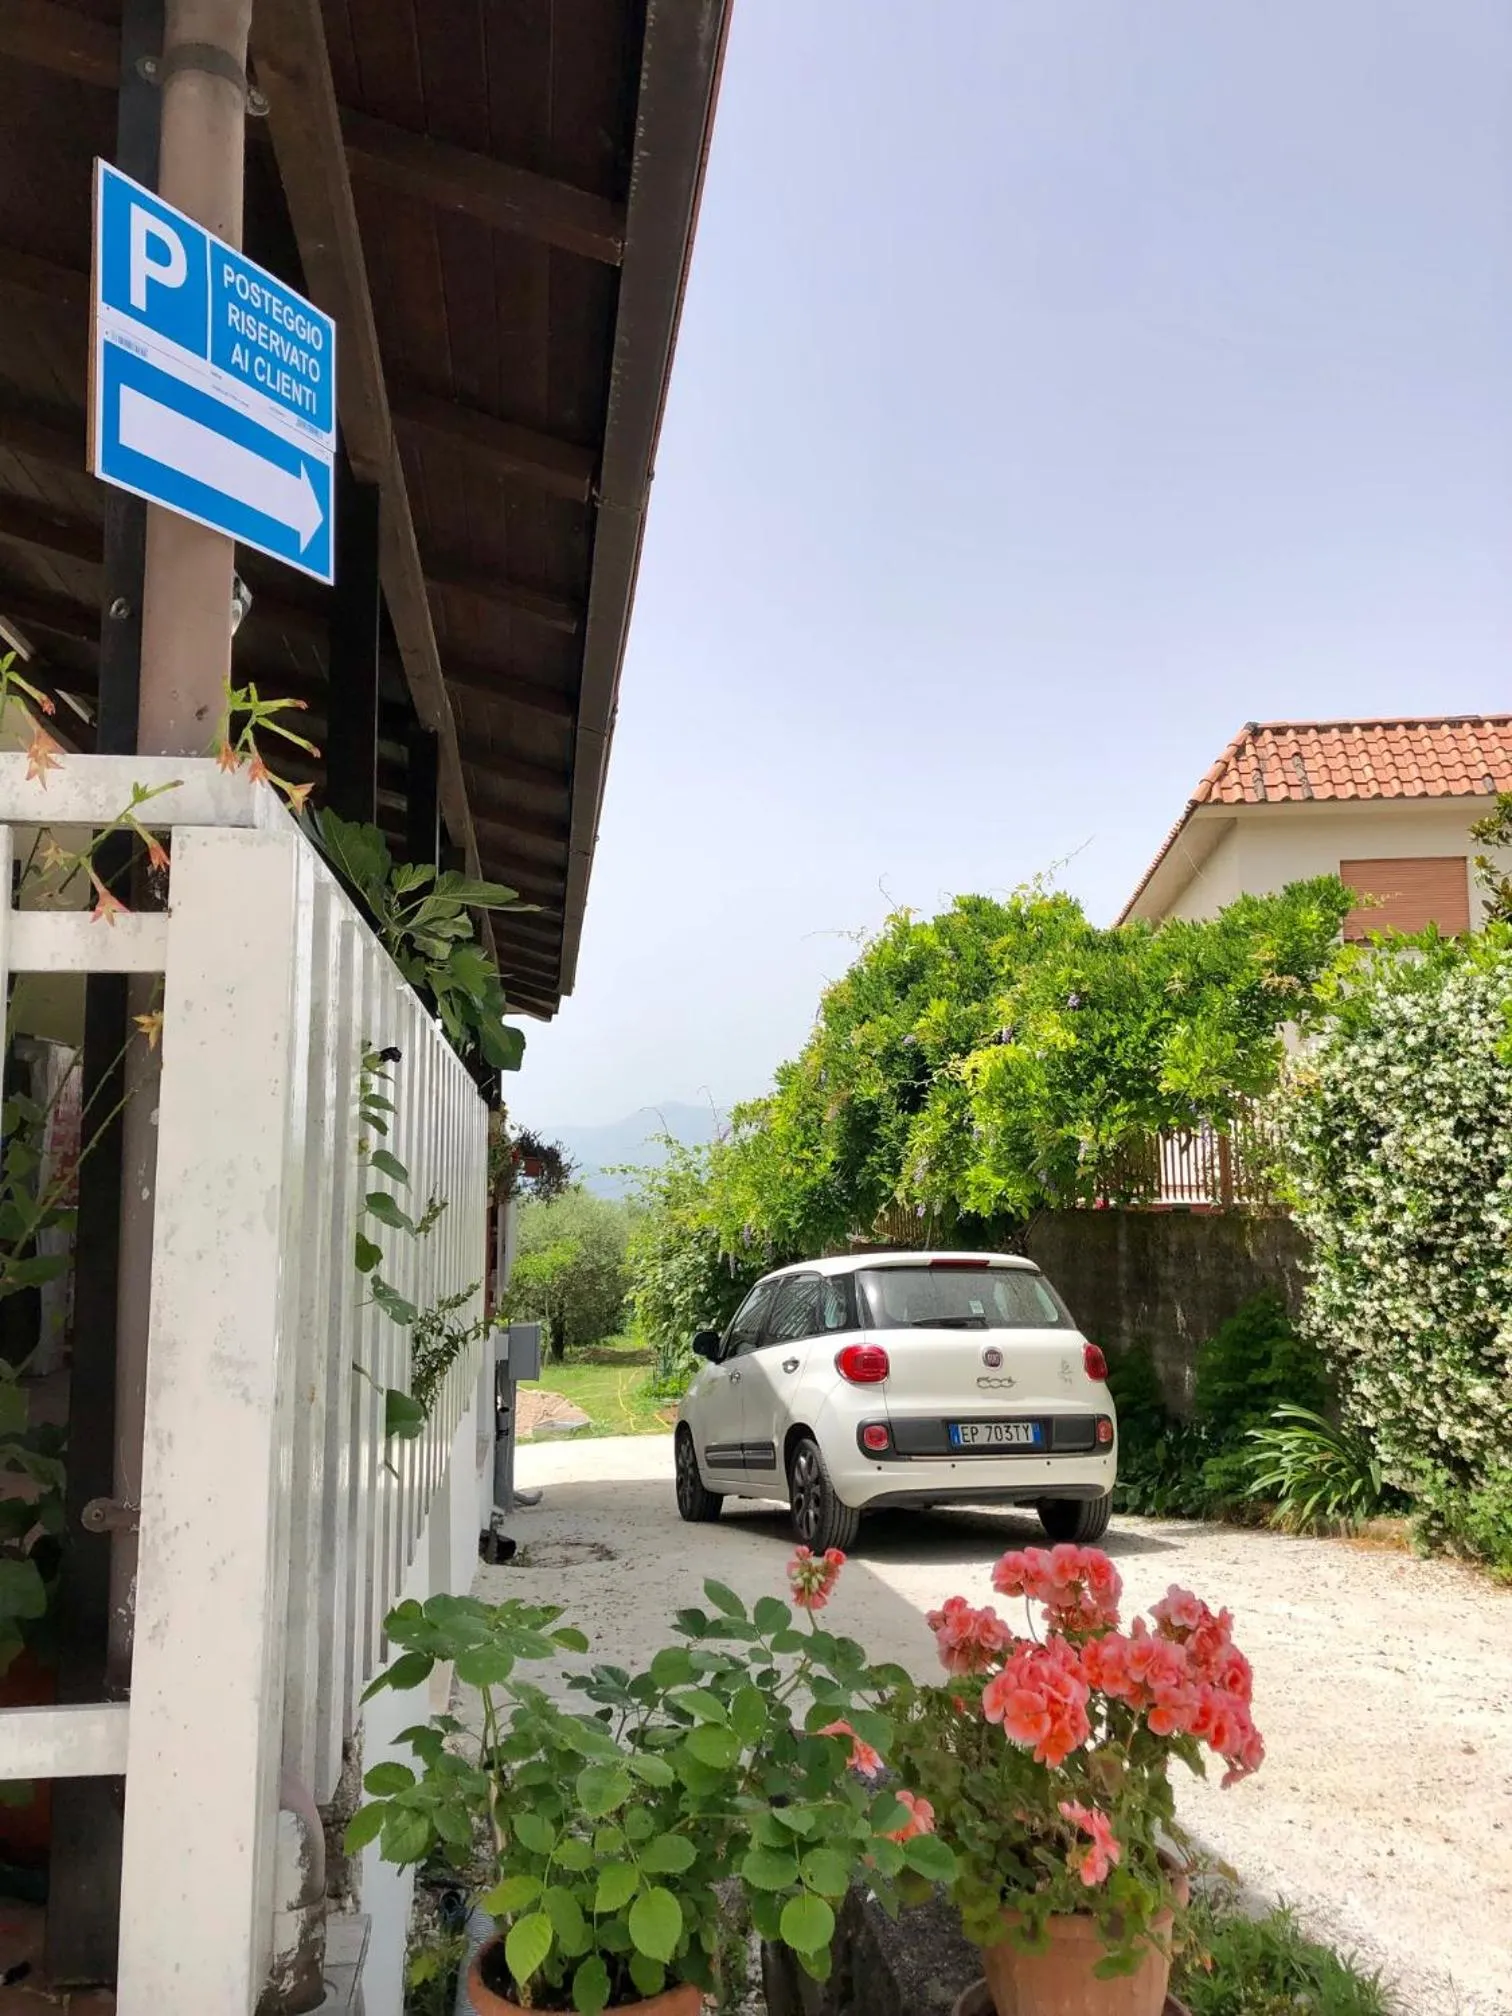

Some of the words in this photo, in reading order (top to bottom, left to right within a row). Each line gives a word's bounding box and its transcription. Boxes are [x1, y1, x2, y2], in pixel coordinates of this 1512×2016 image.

[130, 202, 188, 311] P
[223, 263, 323, 351] POSTEGGIO
[228, 301, 321, 383] RISERVATO
[231, 342, 249, 373] AI
[254, 356, 317, 415] CLIENTI
